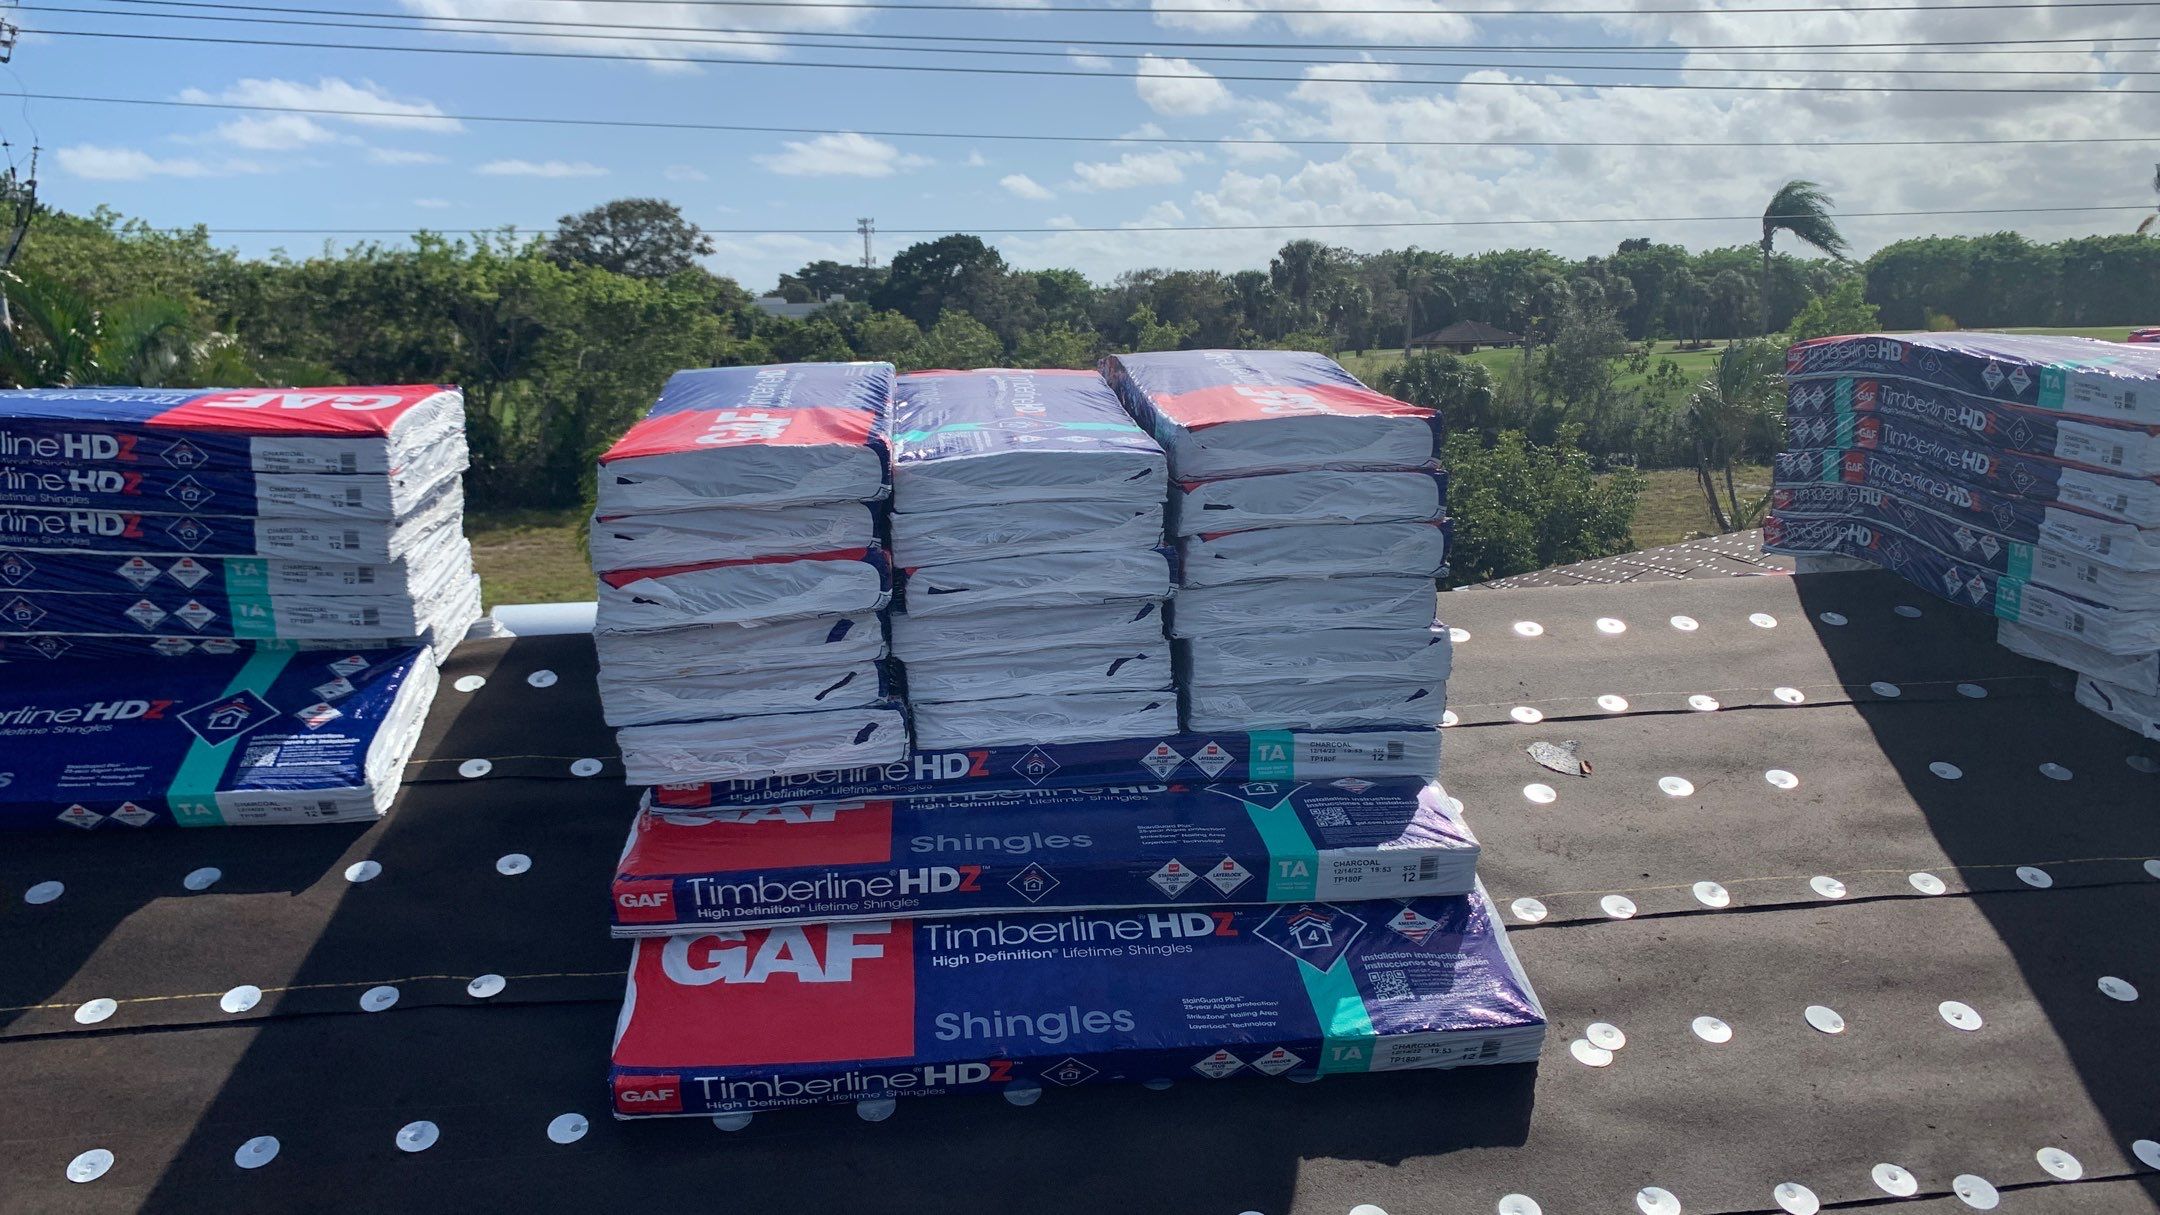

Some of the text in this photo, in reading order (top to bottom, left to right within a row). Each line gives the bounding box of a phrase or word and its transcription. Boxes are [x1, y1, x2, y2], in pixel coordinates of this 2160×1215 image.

[2045, 374, 2060, 390] TA
[1857, 391, 1875, 402] GAF
[1882, 385, 1958, 423] Timberline
[1859, 427, 1877, 439] GAF
[1883, 423, 1960, 467] Timberline
[329, 542, 341, 550] 12
[1257, 743, 1287, 762] TA
[730, 791, 759, 803] High
[178, 803, 212, 816] TA
[910, 802, 944, 810] High
[911, 832, 1093, 854] Shingles
[1279, 860, 1310, 878] TA
[1333, 859, 1380, 868] CHARCOAL
[1333, 867, 1362, 875] 12/14/22
[1402, 872, 1416, 882] 12
[619, 893, 668, 907] GAF
[698, 907, 730, 920] High
[863, 896, 920, 910] Shingles
[1308, 929, 1320, 941] 4
[661, 922, 891, 987] GAF
[933, 954, 970, 969] High
[1128, 943, 1193, 957] Shingles
[1361, 951, 1468, 962] Installation instructions
[1364, 960, 1426, 970] Instrucciones
[1230, 1010, 1258, 1018] Nailing
[935, 1006, 1136, 1044] Shingles
[1232, 1021, 1277, 1029] Technology
[1391, 1042, 1441, 1050] CHARCOAL
[1332, 1046, 1363, 1061] TA
[620, 1088, 675, 1102] GAF
[706, 1101, 741, 1110] High
[886, 1088, 946, 1097] Shingles
